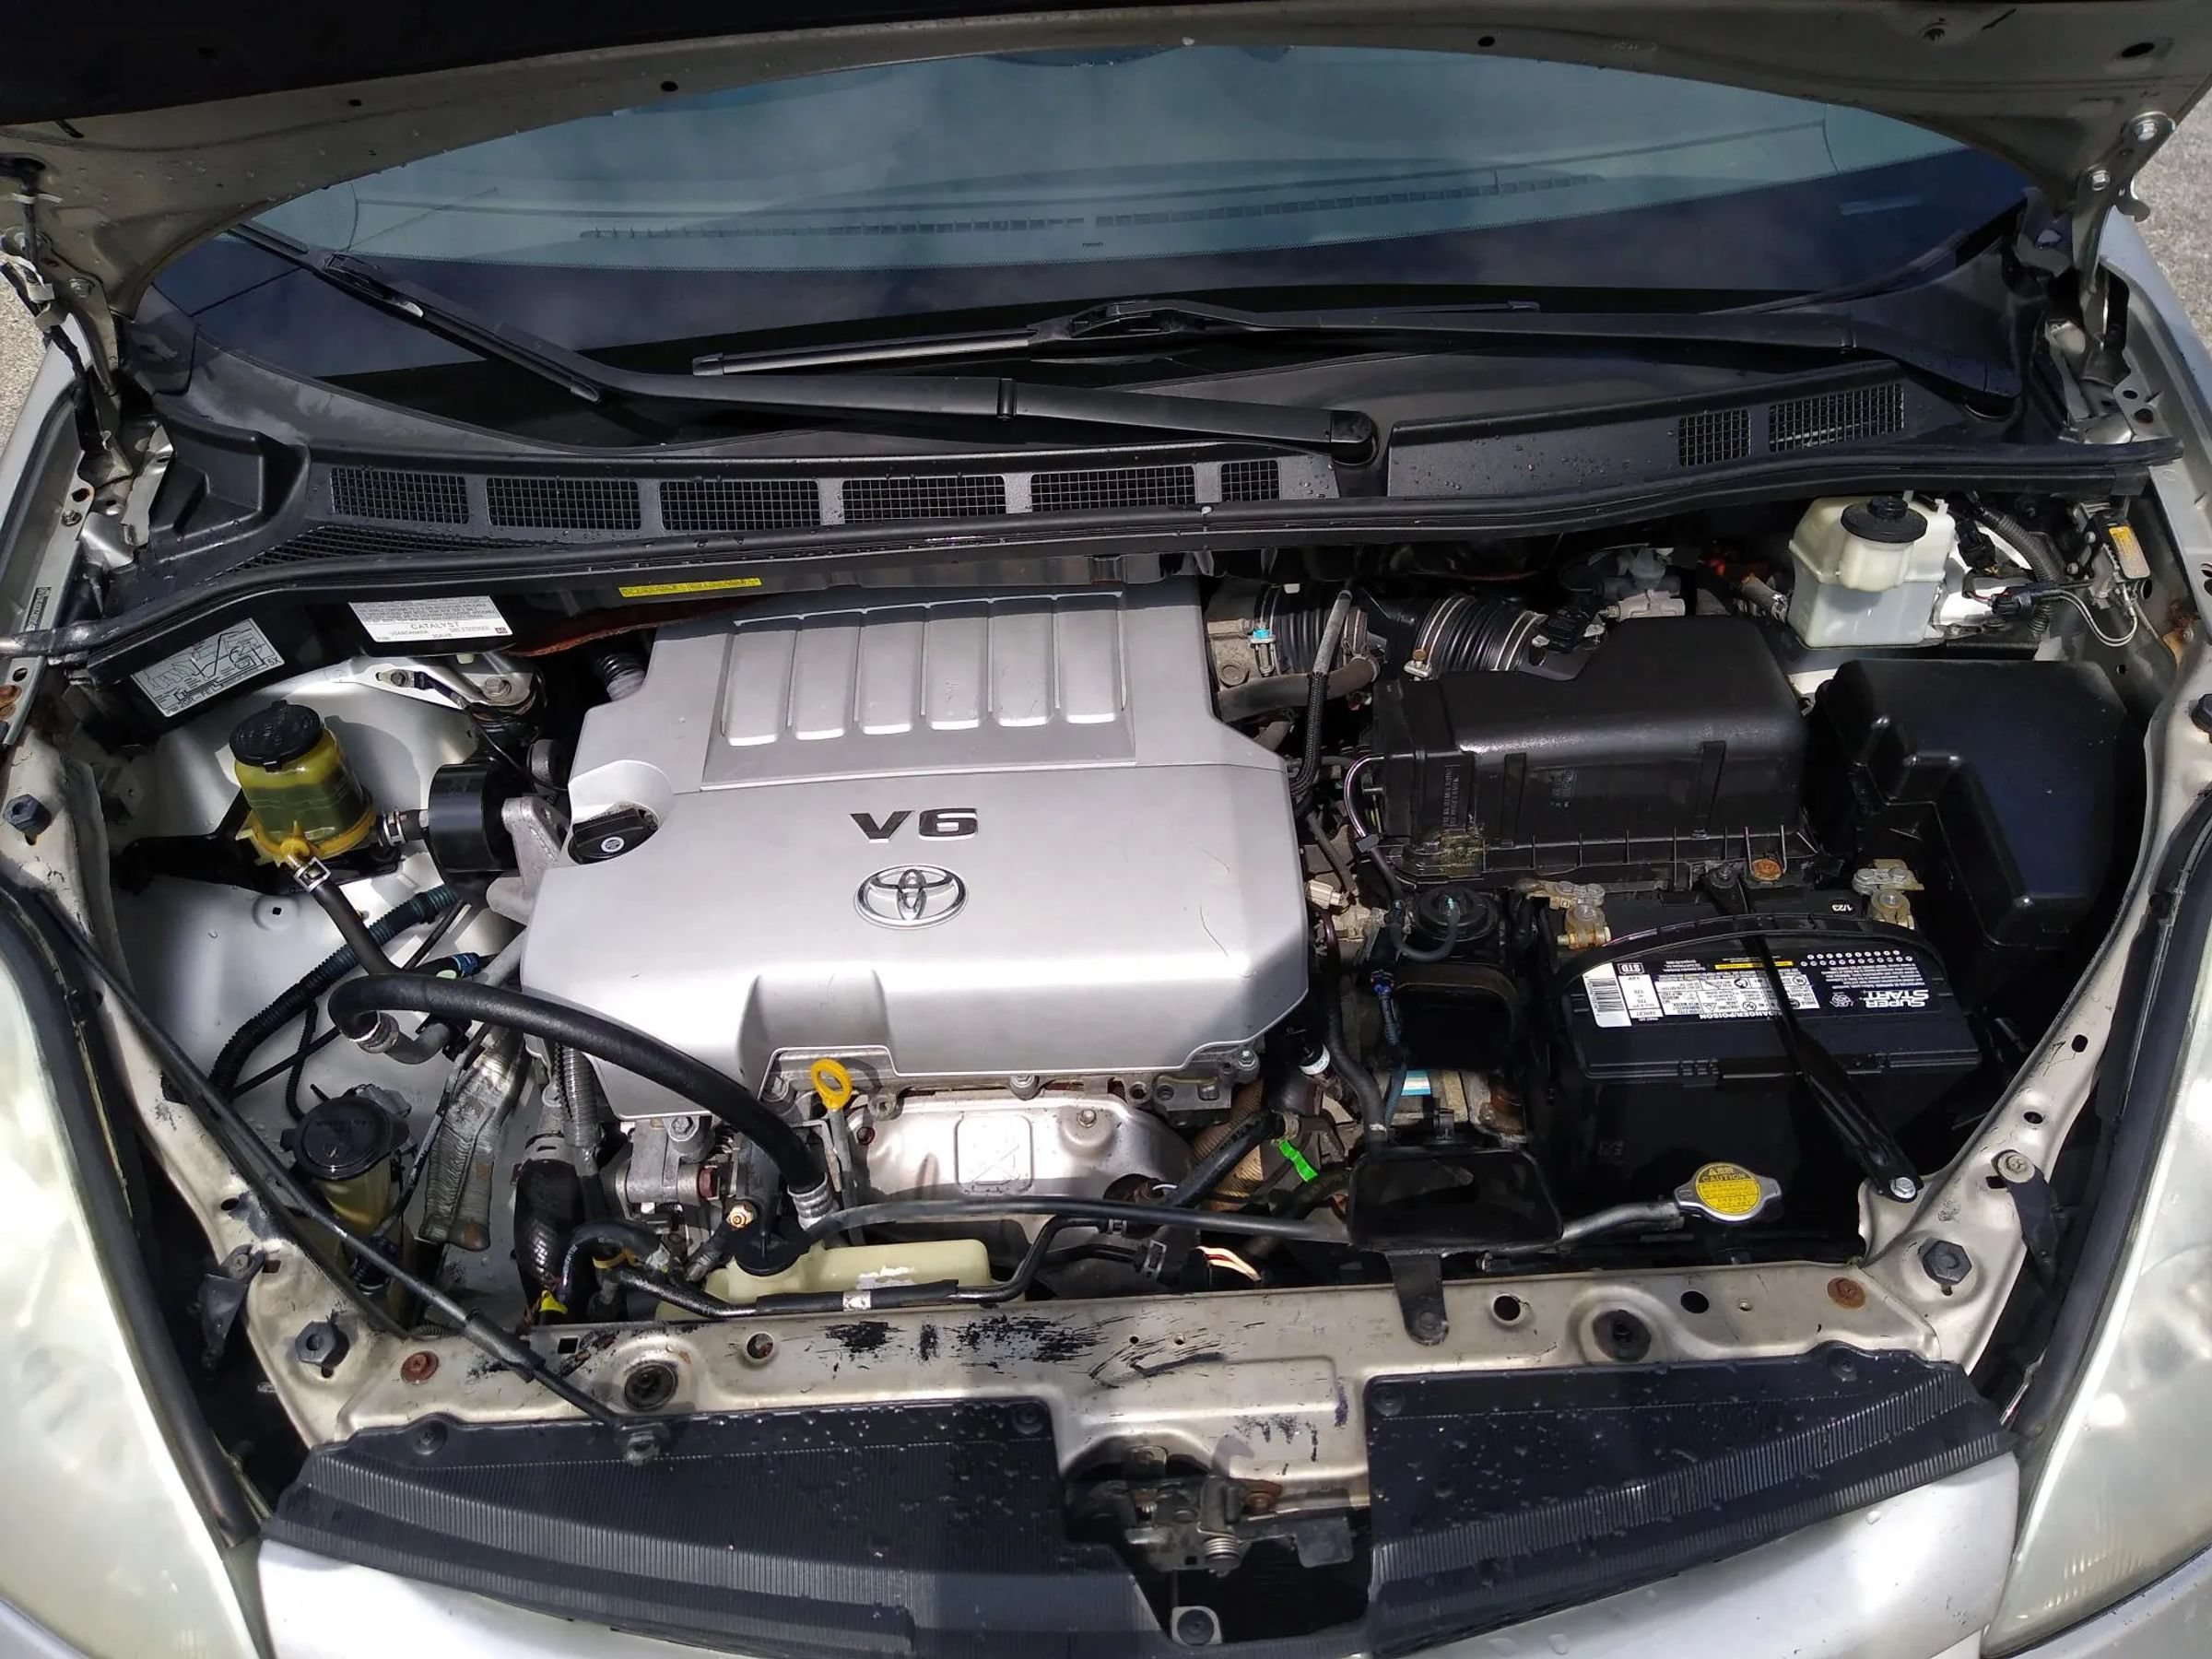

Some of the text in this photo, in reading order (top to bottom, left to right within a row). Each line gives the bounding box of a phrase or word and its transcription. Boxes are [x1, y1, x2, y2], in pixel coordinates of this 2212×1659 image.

[410, 620, 460, 630] CATALYST
[849, 807, 978, 843] V6
[1865, 989, 1929, 1001] START
[1865, 996, 1925, 1008] SUPER
[1701, 1172, 1746, 1182] CAUTION
